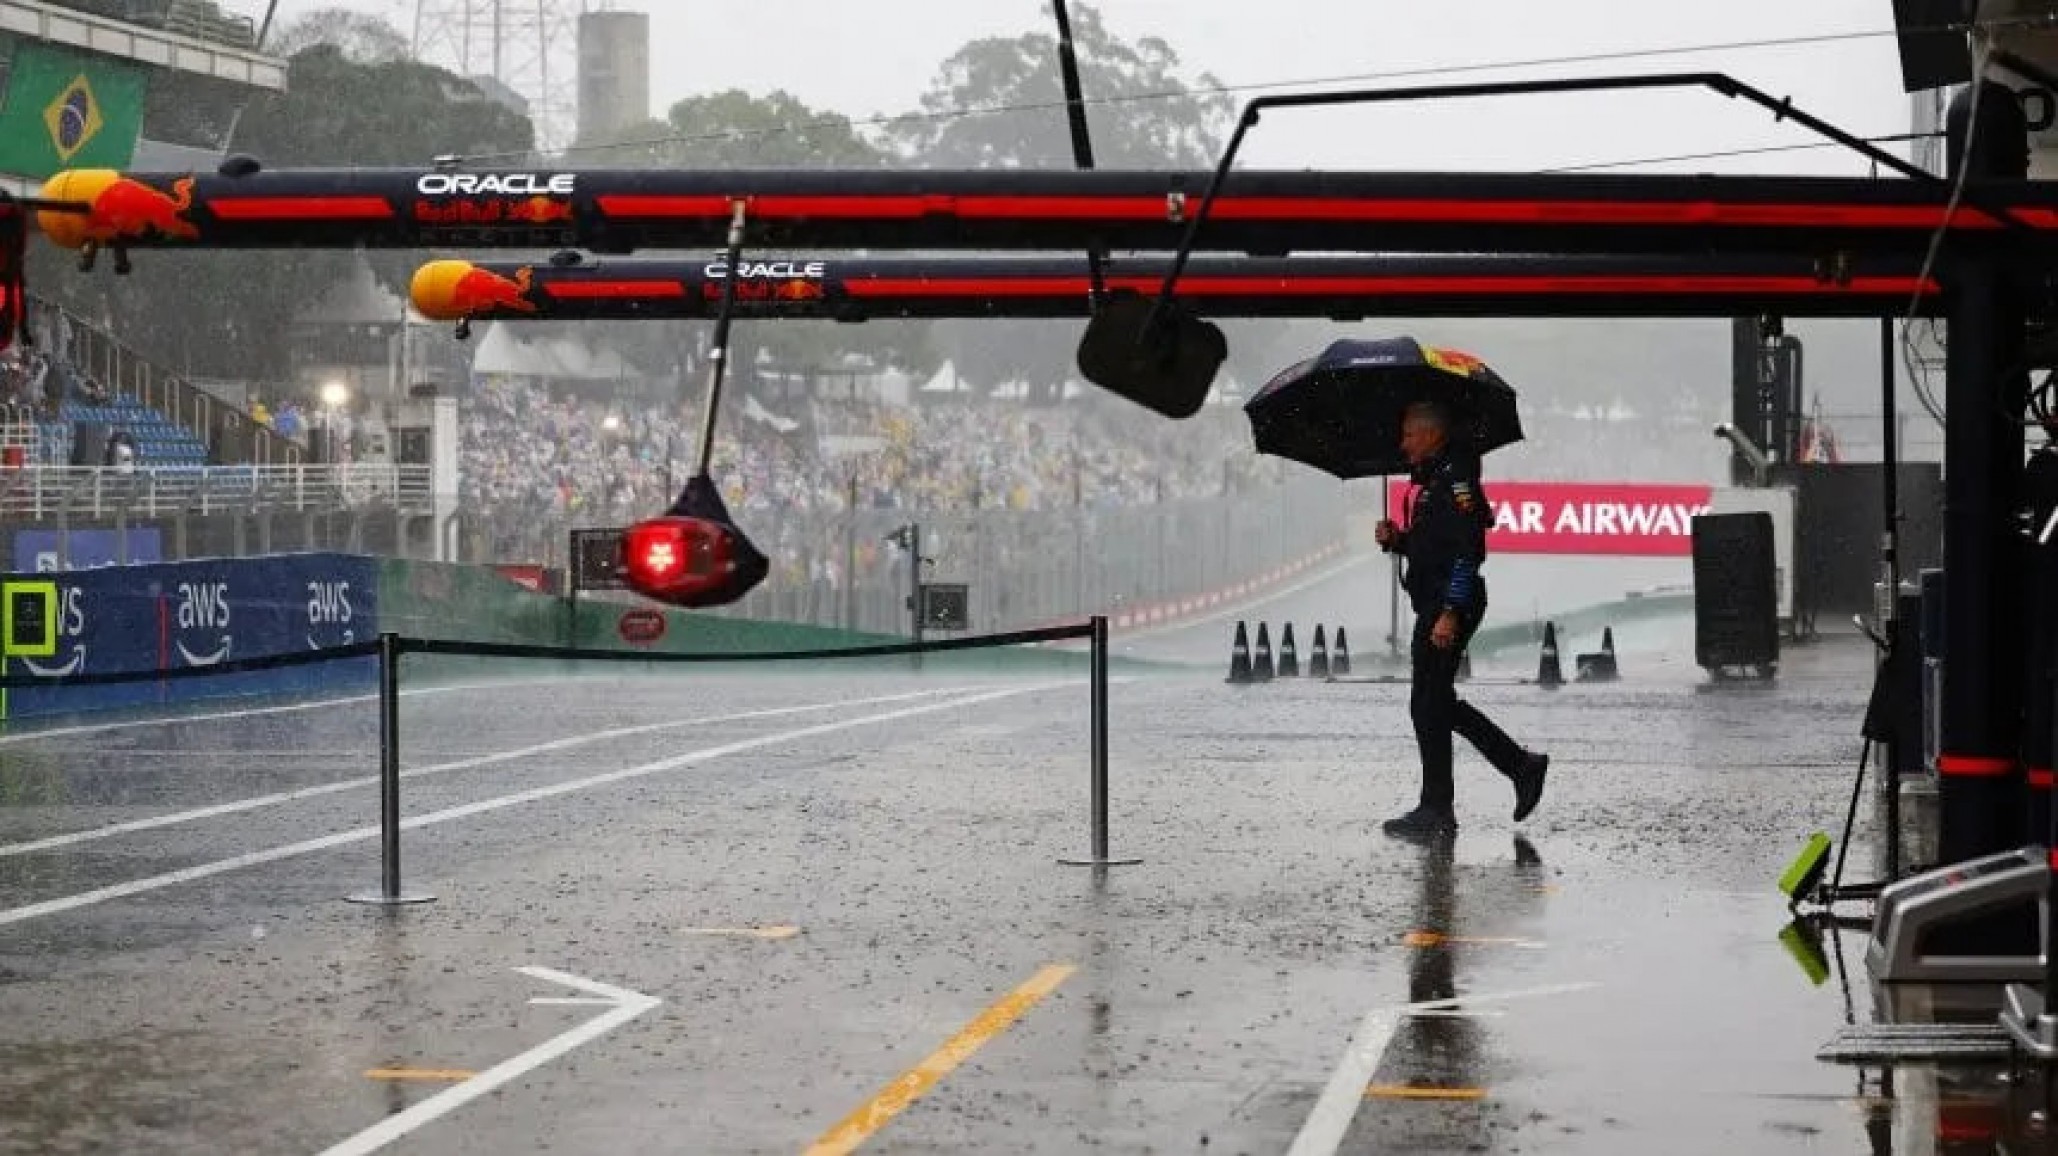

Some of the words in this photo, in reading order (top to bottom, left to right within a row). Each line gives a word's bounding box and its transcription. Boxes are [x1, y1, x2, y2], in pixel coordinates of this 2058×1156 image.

[417, 173, 576, 194] ORACLE
[1553, 501, 1712, 536] AIRWAY
[178, 582, 230, 629] aws
[307, 580, 351, 623] aws
